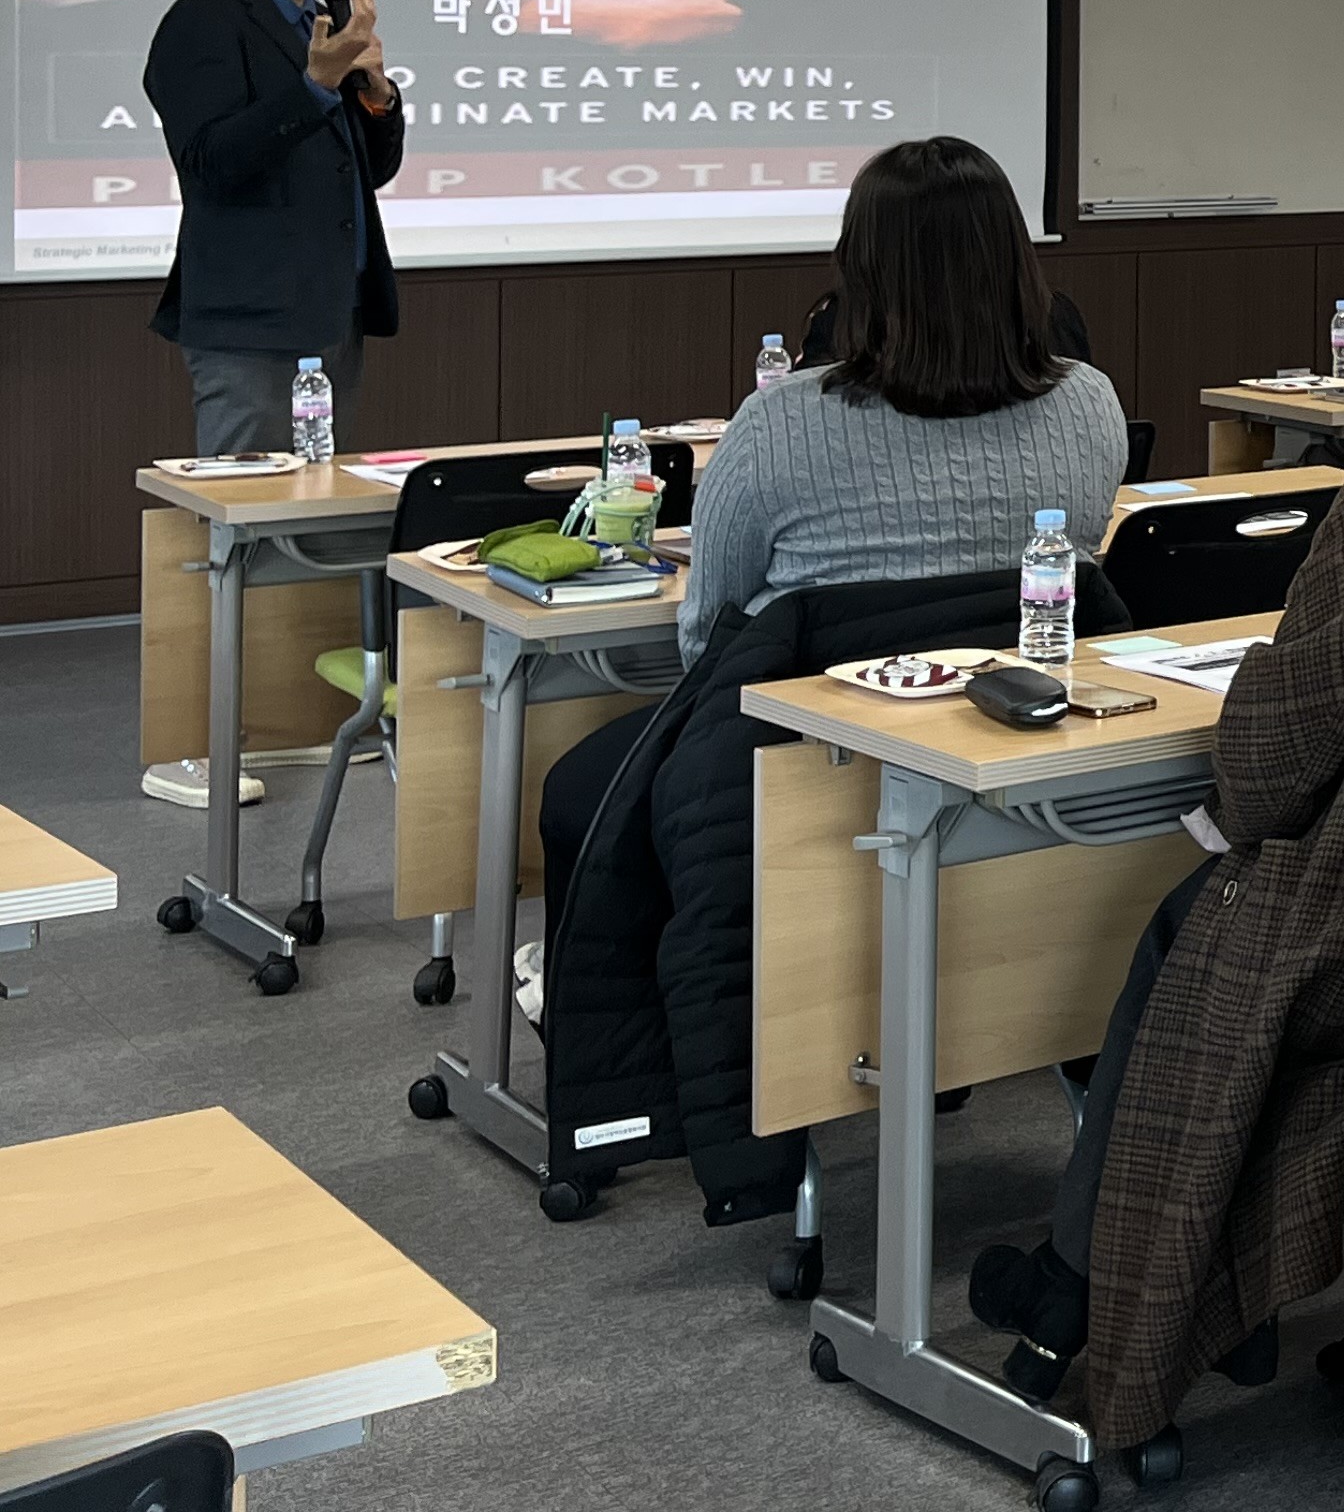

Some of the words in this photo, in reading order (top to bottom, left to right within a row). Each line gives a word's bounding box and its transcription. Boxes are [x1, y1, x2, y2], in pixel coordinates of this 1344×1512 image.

[454, 65, 701, 91] CREATE,
[736, 65, 854, 90] WIN,
[641, 98, 896, 123] MARKETS
[541, 161, 838, 193] KOTLE
[96, 244, 161, 258] Marketing
